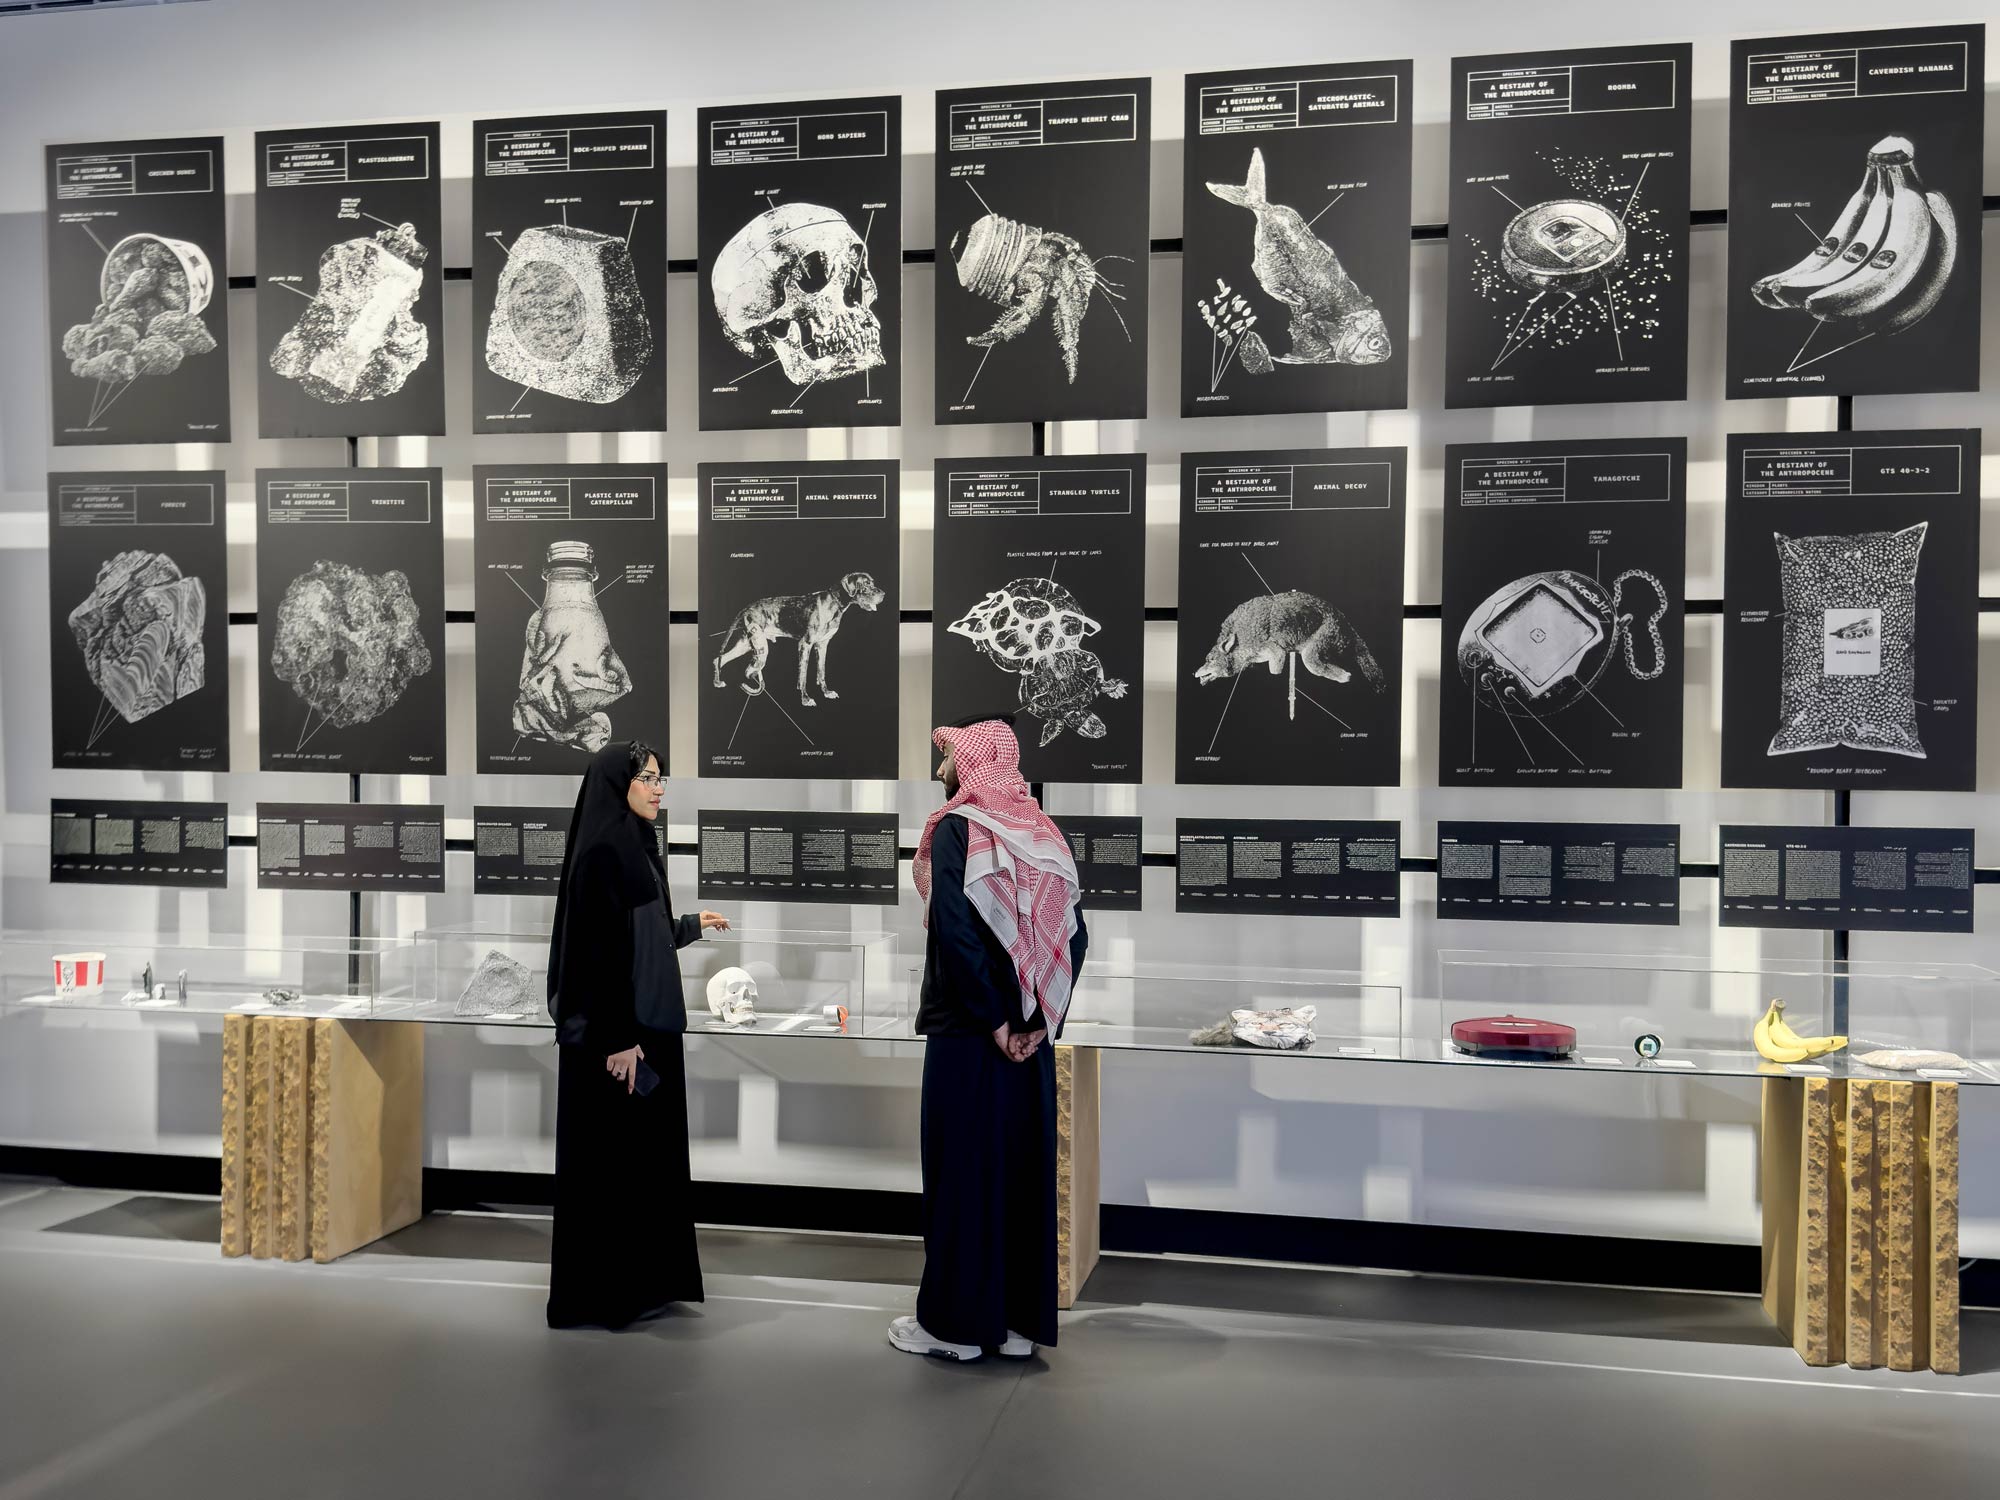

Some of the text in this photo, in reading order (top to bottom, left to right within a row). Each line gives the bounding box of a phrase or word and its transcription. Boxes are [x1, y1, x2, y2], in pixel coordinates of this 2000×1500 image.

[1781, 65, 1819, 73] BESTIARY
[1868, 64, 1954, 76] CAVENDISH BANANAS
[1765, 72, 1840, 83] THE ANTHROPOCENE
[1499, 82, 1535, 90] BESTIARY
[1607, 83, 1637, 91] ROOMBA
[1501, 89, 1555, 98] ANTHROPOCENE
[1230, 97, 1264, 105] BESTIARY
[1232, 104, 1283, 112] ANTHROPOCENE
[1308, 102, 1349, 111] SATURATED
[1048, 117, 1078, 125] TRAPPED
[980, 121, 1028, 130] ANTHROPOCENE
[739, 137, 785, 145] ANTHROPOCENE
[573, 145, 616, 153] ROCK-SHAPED
[1778, 469, 1835, 477] ANTHROPOCENE
[1899, 467, 1930, 475] 40-3-2
[1593, 475, 1641, 483] TAMAGOTCHI
